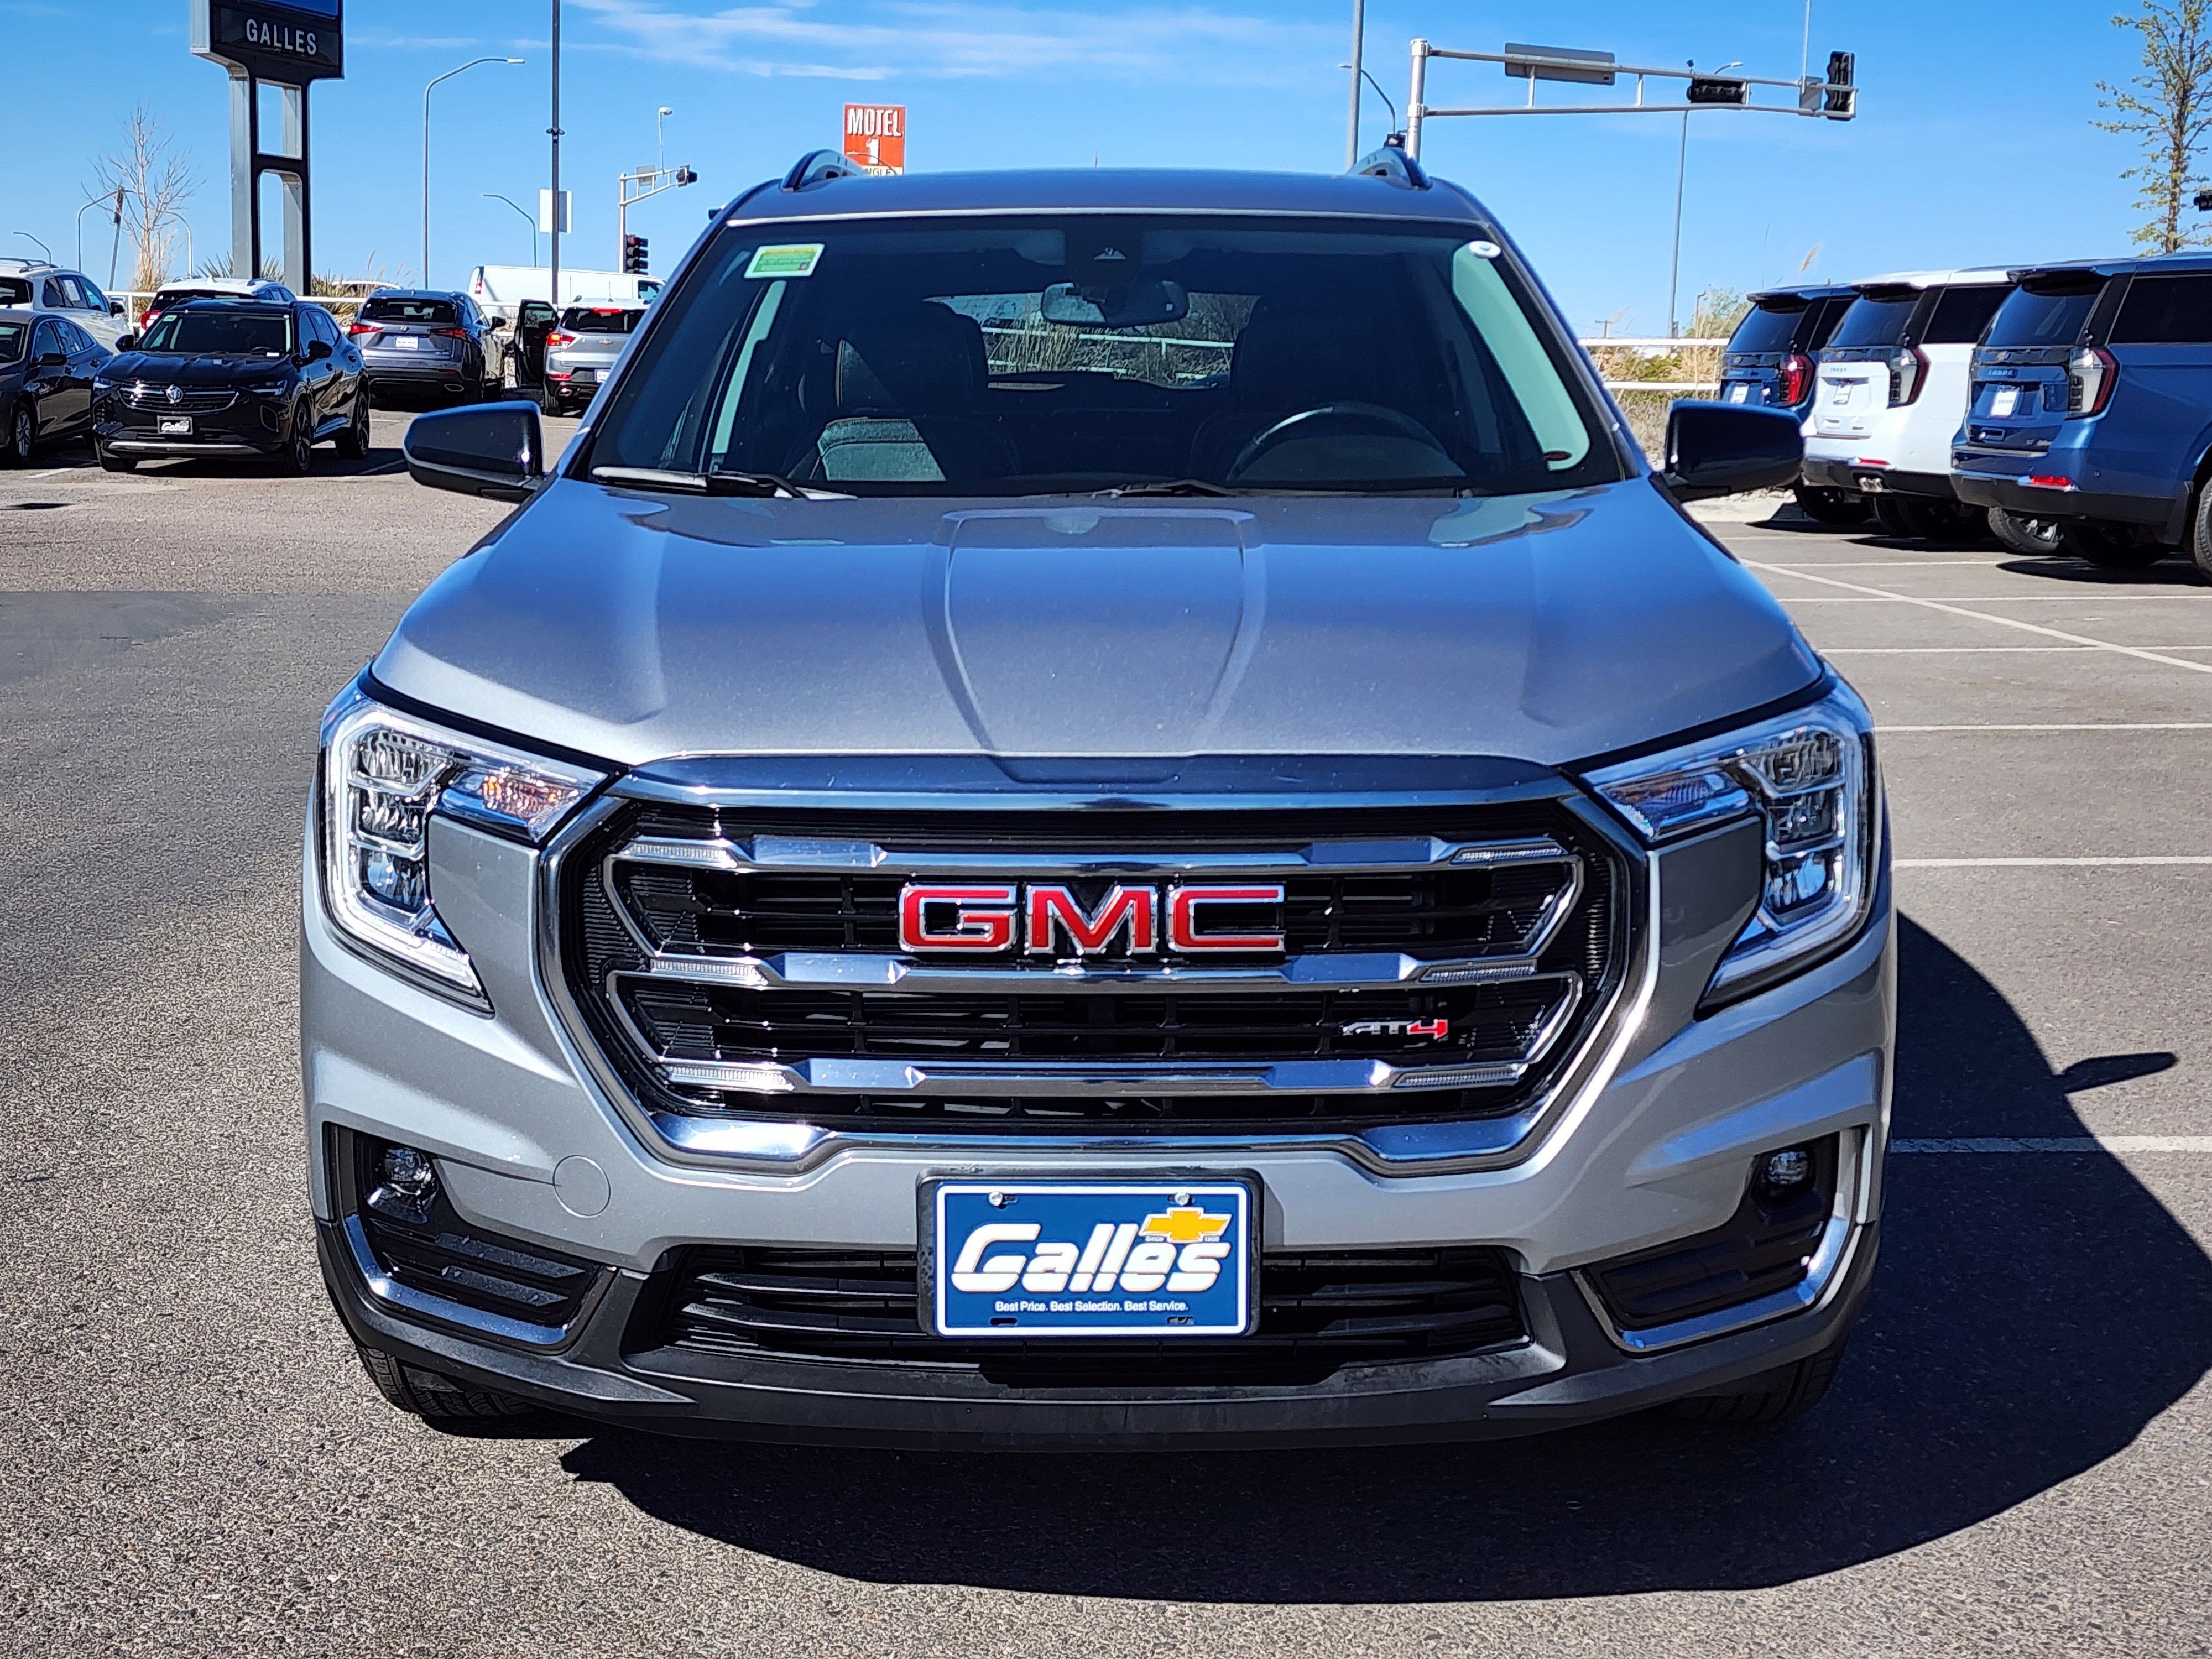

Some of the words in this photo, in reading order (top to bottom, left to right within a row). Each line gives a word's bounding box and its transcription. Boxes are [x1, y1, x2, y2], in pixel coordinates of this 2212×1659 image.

[246, 19, 316, 55] GALLES
[847, 108, 902, 137] MOTEL
[866, 137, 880, 165] 1
[899, 885, 1285, 953] GMC
[1342, 1019, 1448, 1040] AT4
[951, 1223, 1232, 1293] Galles
[995, 1301, 1019, 1312] Best
[1020, 1301, 1048, 1312] Price.
[1050, 1301, 1073, 1312] Best
[1074, 1301, 1123, 1312] Selection.
[1124, 1301, 1147, 1311] Best
[1149, 1300, 1189, 1311] Service.
